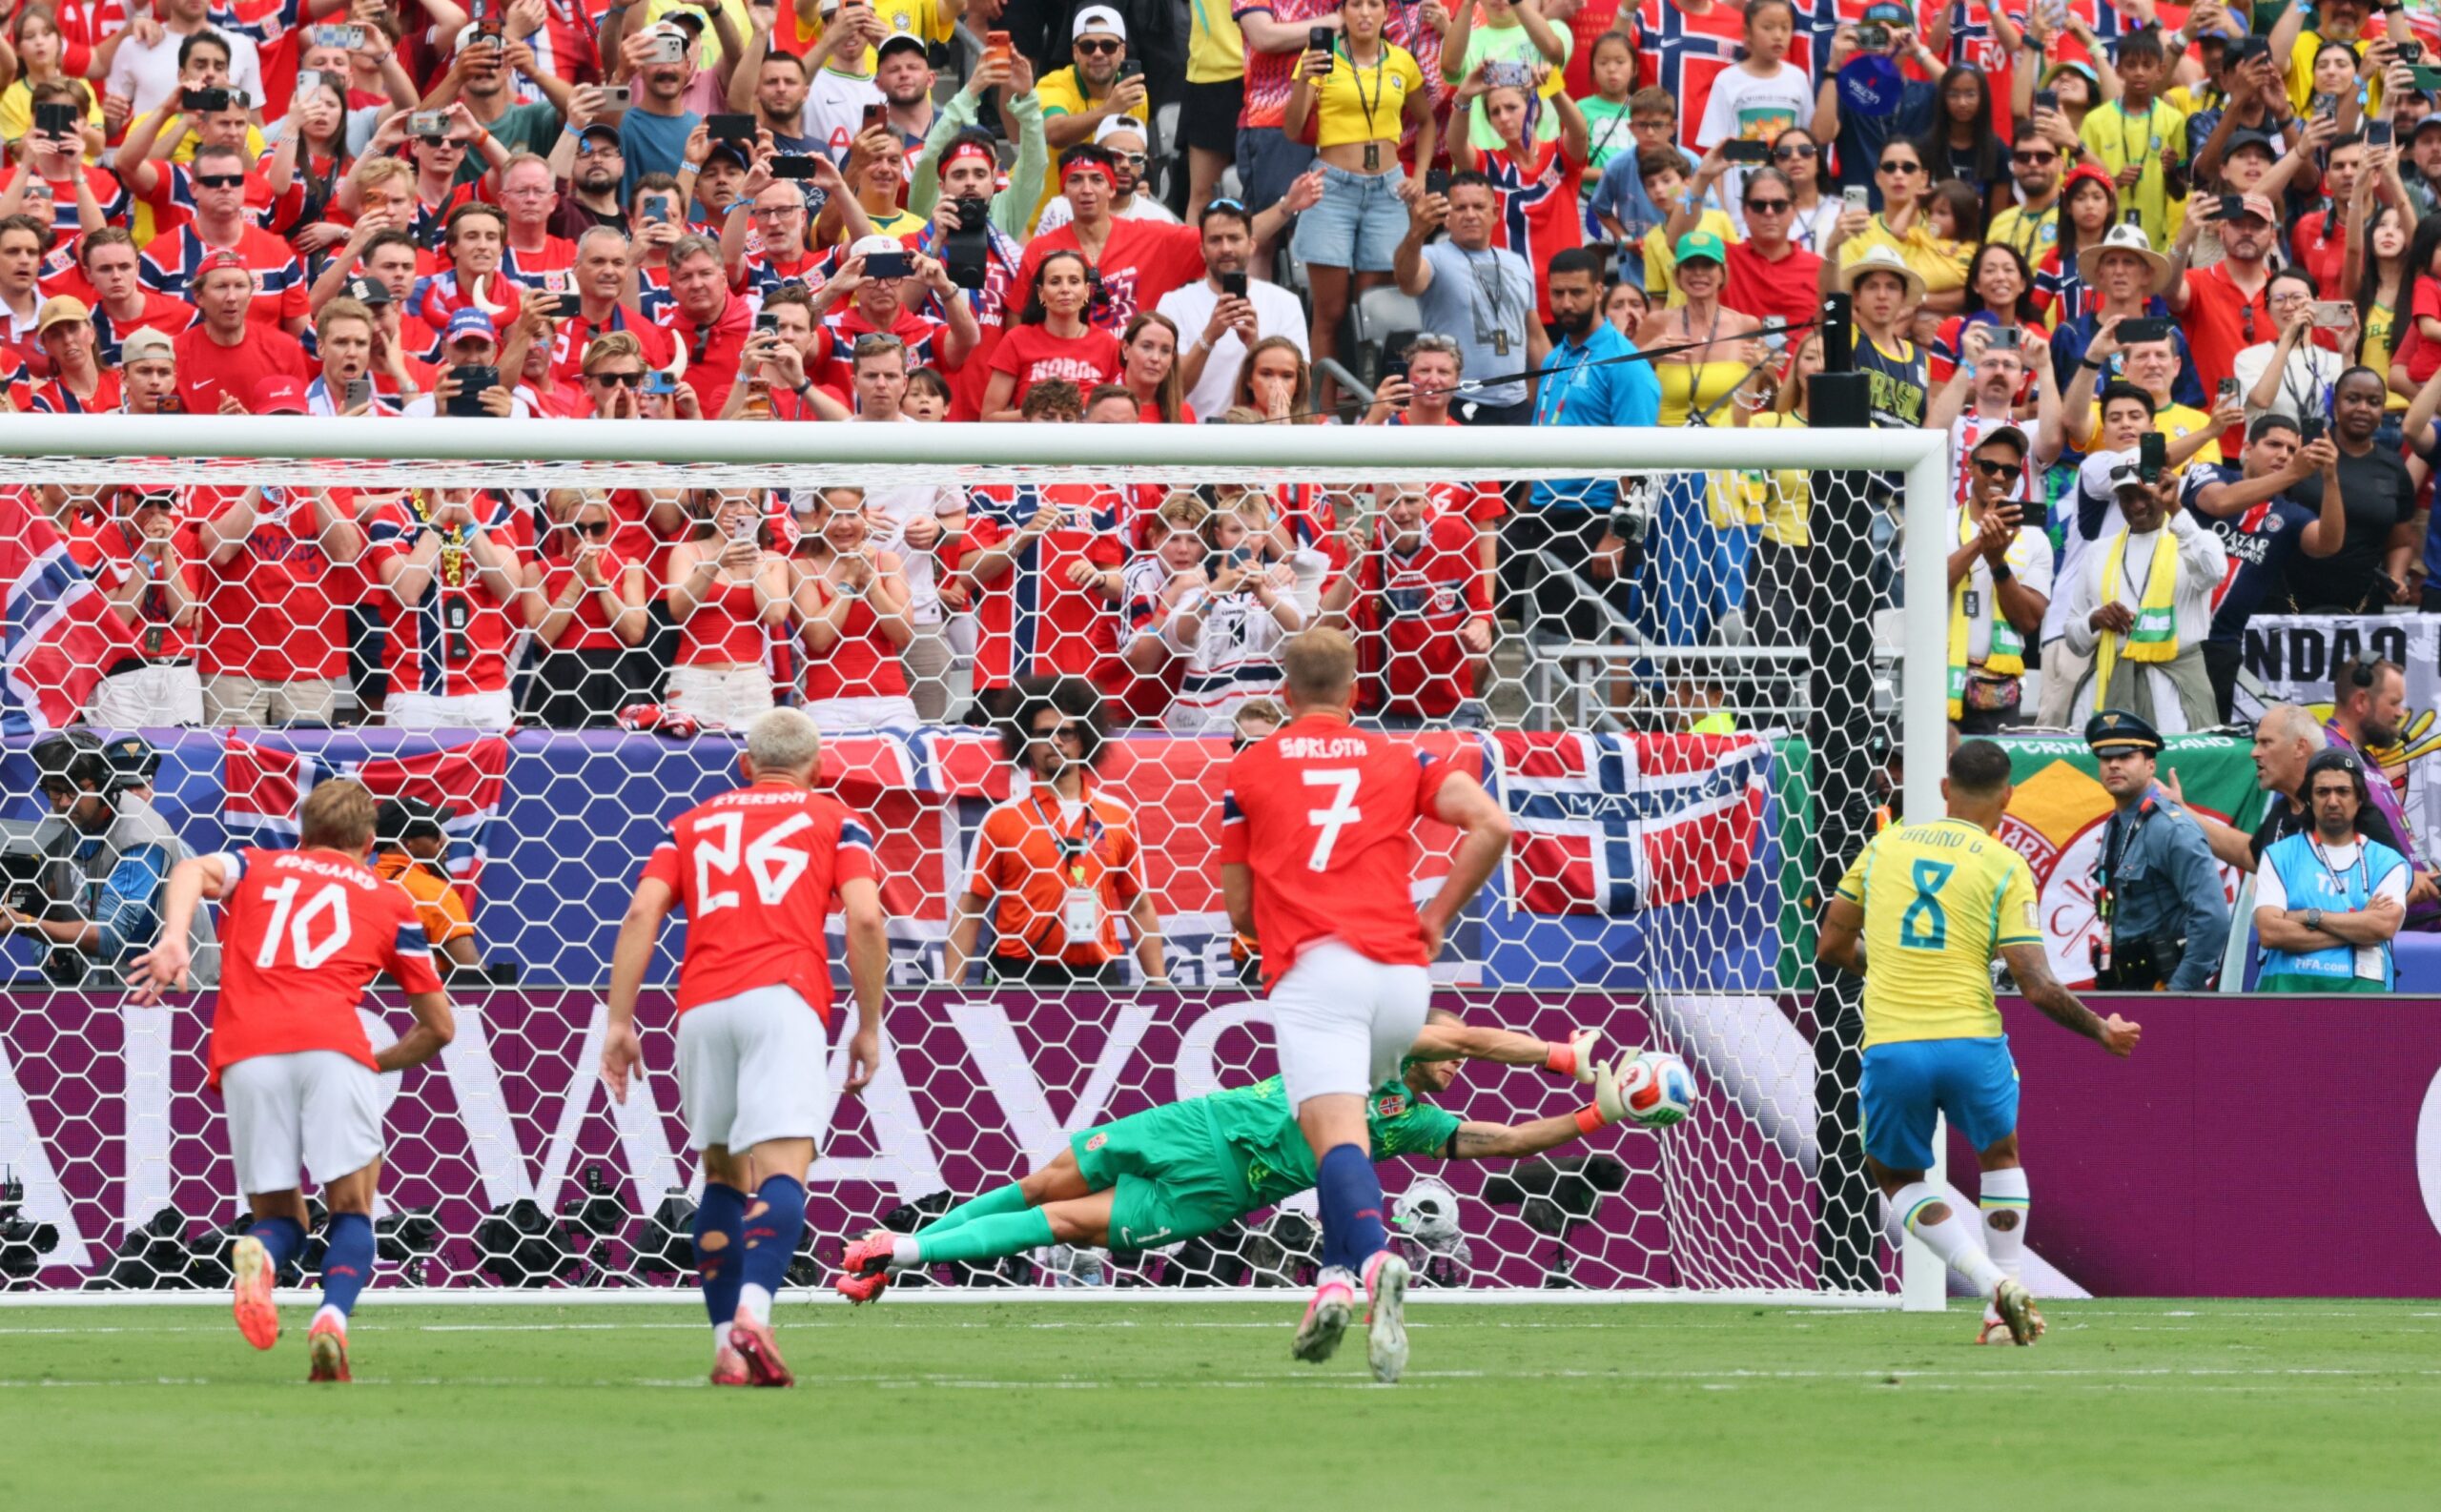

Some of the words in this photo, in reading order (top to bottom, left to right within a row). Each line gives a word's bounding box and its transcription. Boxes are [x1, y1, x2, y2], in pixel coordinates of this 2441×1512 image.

[1860, 366, 1921, 425] RASIL
[2211, 520, 2269, 553] QATAR
[2225, 543, 2267, 565] IRWAYS
[1278, 736, 1368, 759] SØRLOTH
[1302, 767, 1362, 872] 7
[1899, 828, 1966, 848] BRUNO
[1969, 839, 1984, 857] G.
[693, 811, 814, 920] 26
[256, 876, 352, 970] 10
[1899, 858, 1956, 950] 8
[2295, 955, 2349, 973] FIFA.com
